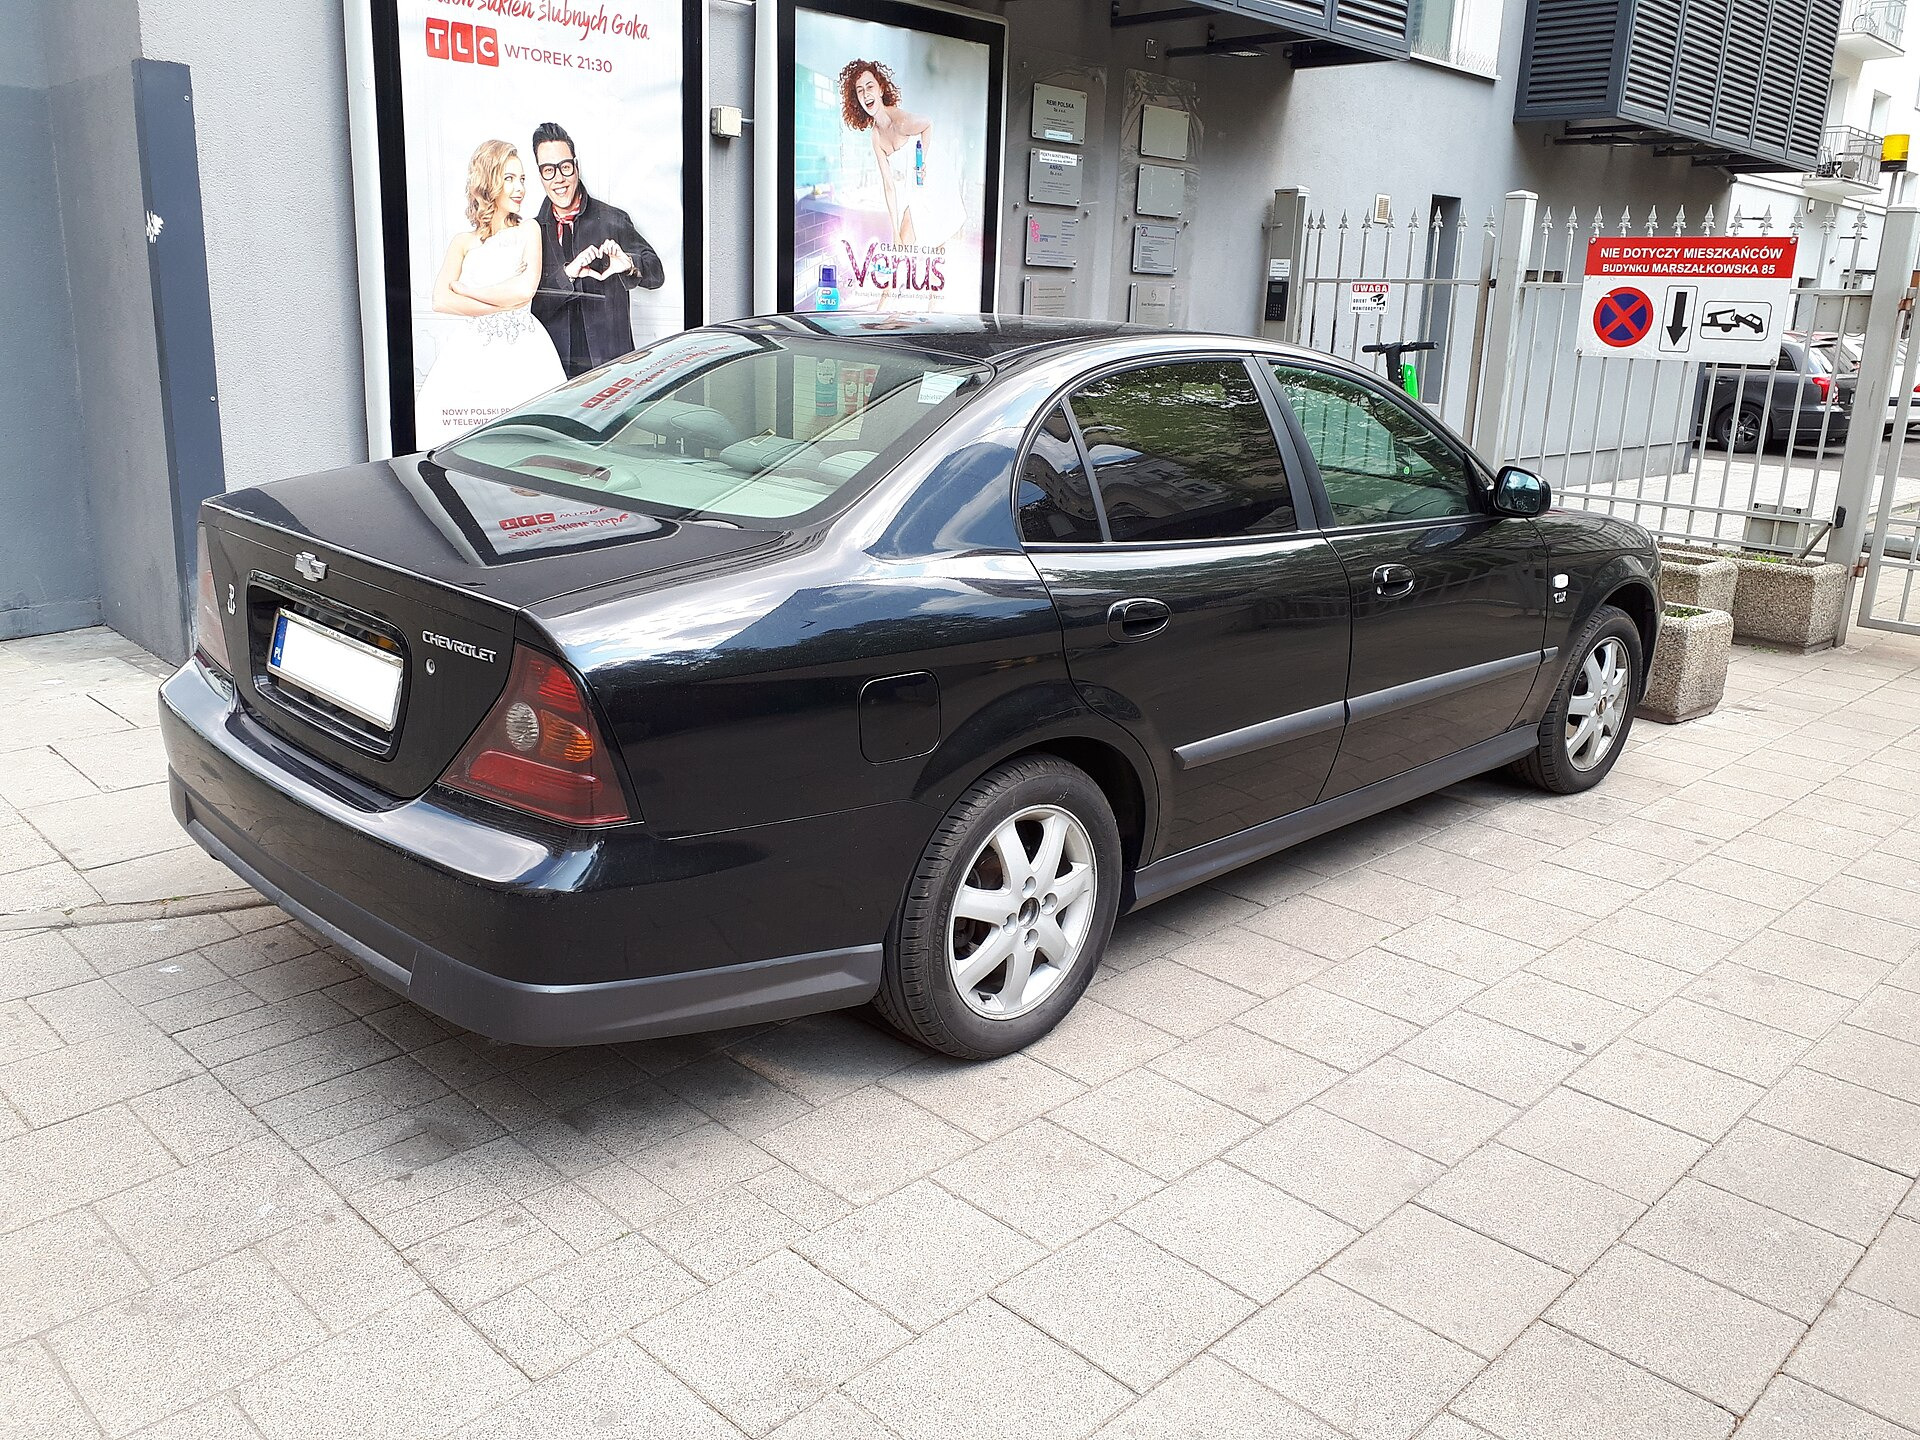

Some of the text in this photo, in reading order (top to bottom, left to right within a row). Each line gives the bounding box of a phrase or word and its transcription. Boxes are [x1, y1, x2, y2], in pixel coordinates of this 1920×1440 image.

[427, 22, 498, 62] TLC
[504, 43, 613, 73] WTOREK 21:30
[880, 243, 946, 255] GŁADKIE CIAŁO
[1600, 245, 1784, 260] NIE DOTYCZY MIESZKAŃCÓW
[841, 239, 946, 292] Venus
[1602, 263, 1776, 275] BUDYNKU MARSZAŁKOWSKA 85
[1353, 284, 1388, 293] UWAGA
[470, 408, 500, 416] POLSKI
[273, 645, 283, 662] PL
[421, 630, 498, 664] CHEVROLET
